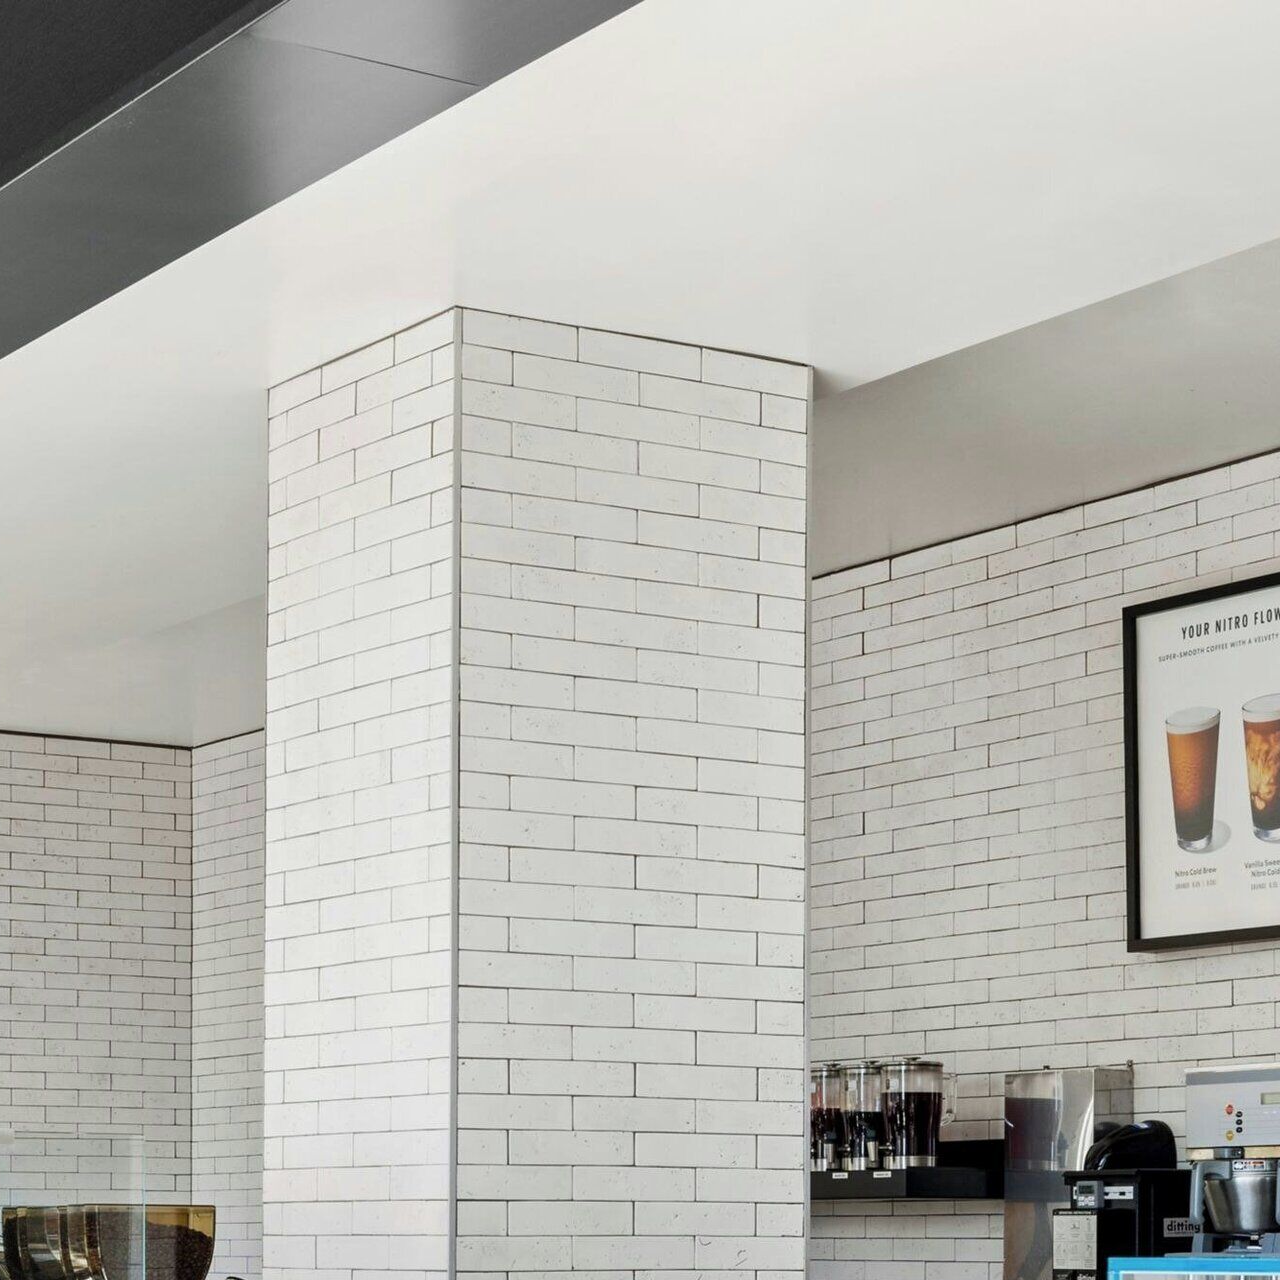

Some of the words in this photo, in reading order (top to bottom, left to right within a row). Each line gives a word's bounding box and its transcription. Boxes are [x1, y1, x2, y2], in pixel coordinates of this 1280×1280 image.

[1182, 622, 1209, 640] YOUR
[1215, 614, 1248, 633] NITRO
[1206, 643, 1228, 653] COFFEE
[1230, 639, 1246, 648] WITH
[1254, 633, 1279, 643] VELVETY
[1244, 860, 1263, 869] Vanilla
[1175, 869, 1189, 877] Nitro
[1190, 868, 1202, 876] Cold
[1267, 868, 1280, 876] Cold
